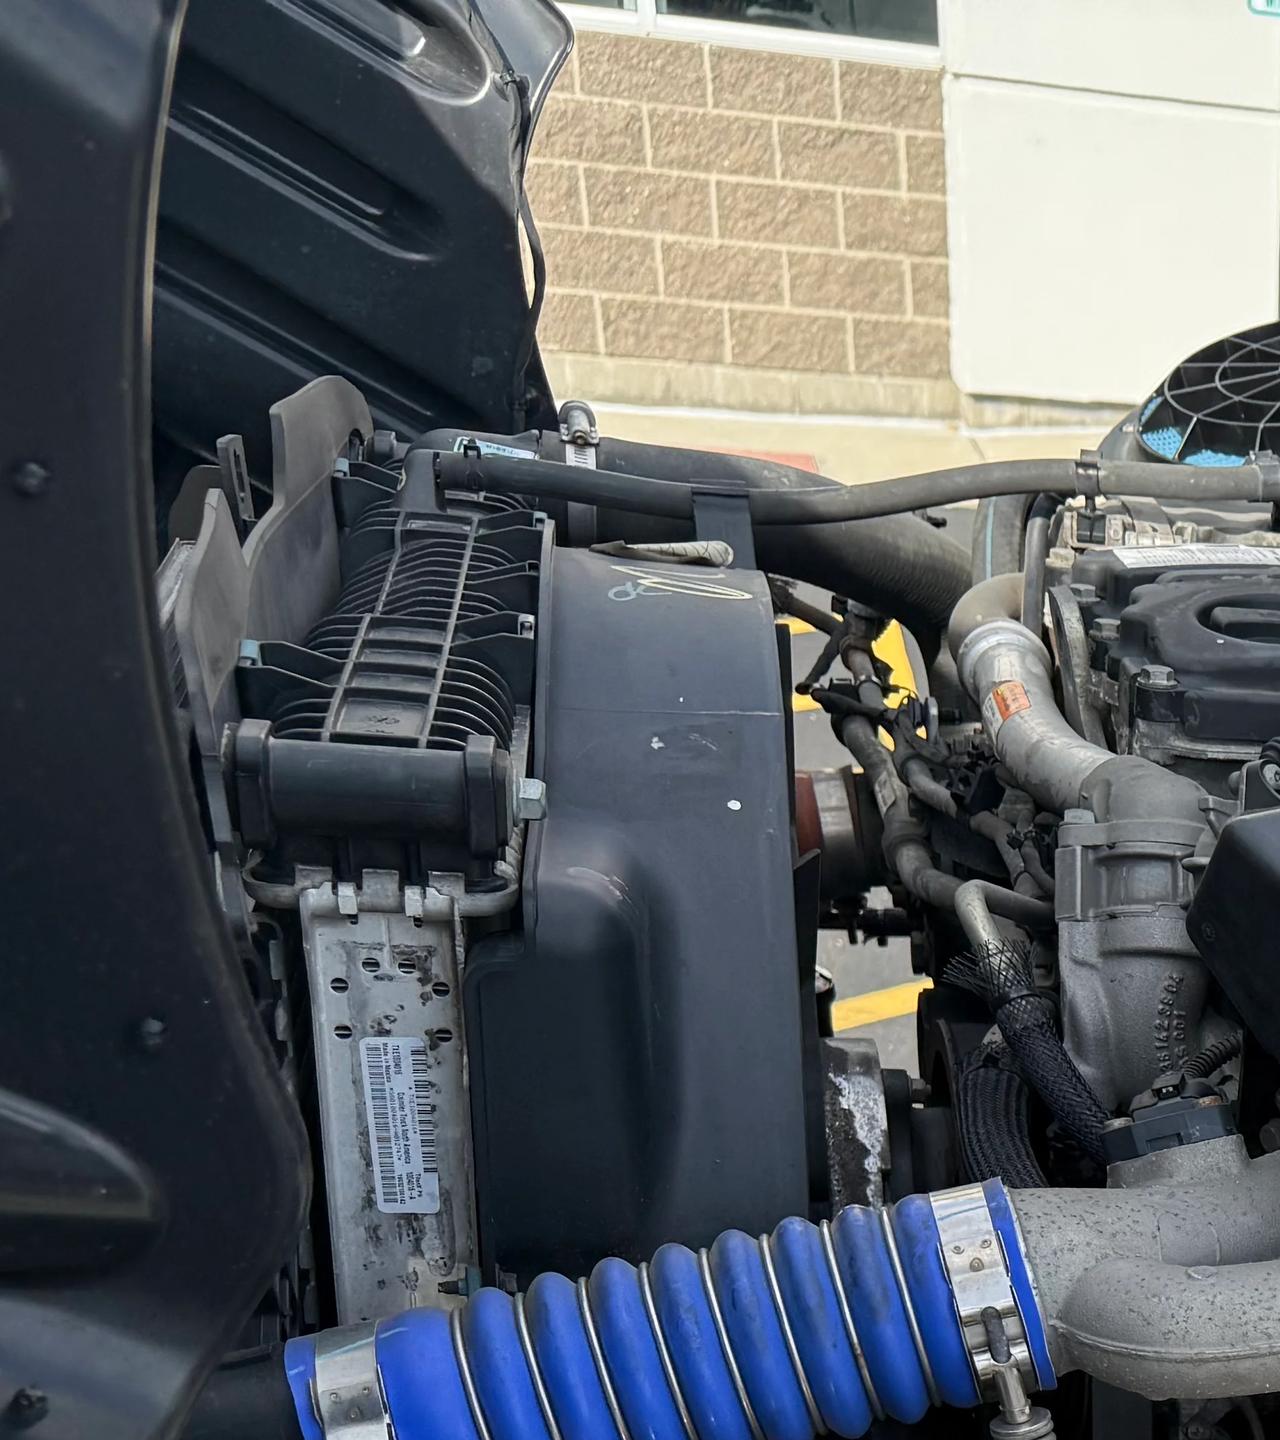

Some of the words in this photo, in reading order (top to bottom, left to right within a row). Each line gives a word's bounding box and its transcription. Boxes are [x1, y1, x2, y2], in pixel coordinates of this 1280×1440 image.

[381, 1042, 389, 1057] Made
[384, 1064, 392, 1083] Mexico
[399, 1113, 408, 1127] Truck
[402, 1143, 412, 1164] America
